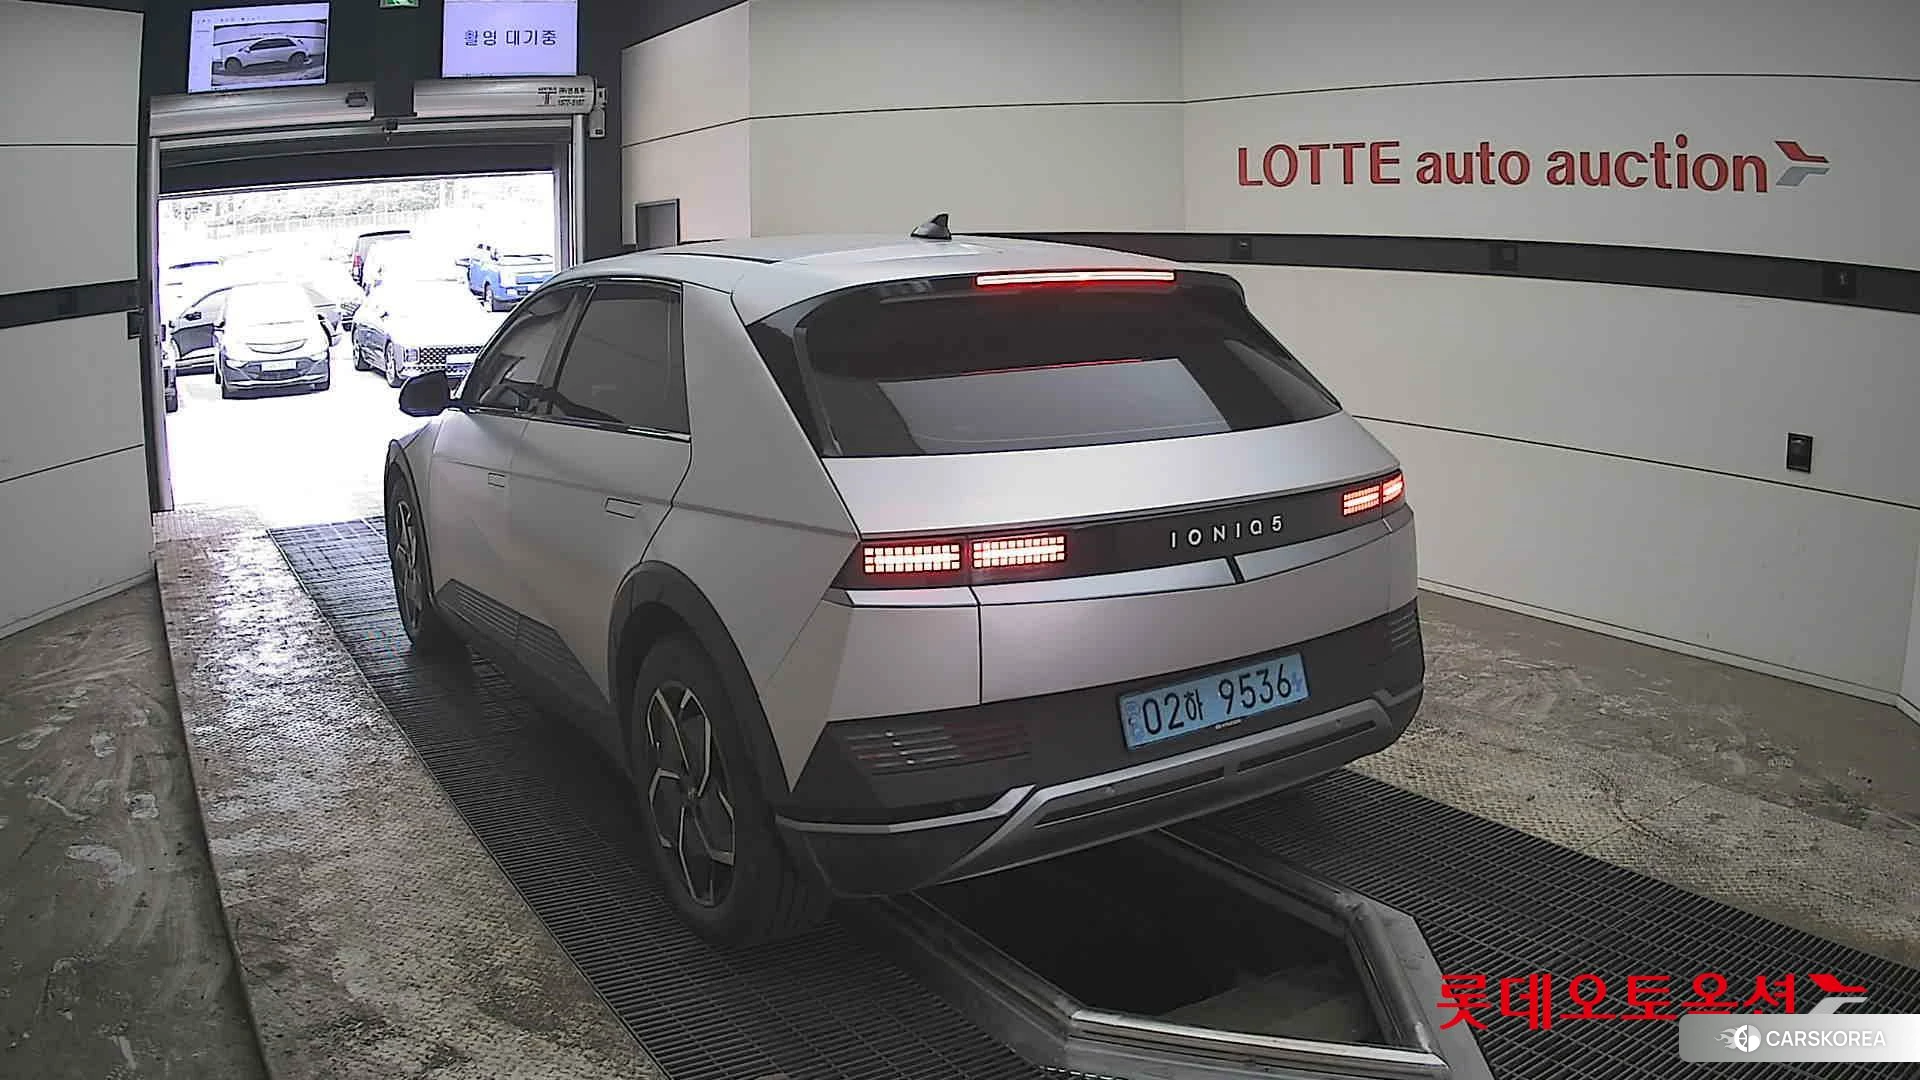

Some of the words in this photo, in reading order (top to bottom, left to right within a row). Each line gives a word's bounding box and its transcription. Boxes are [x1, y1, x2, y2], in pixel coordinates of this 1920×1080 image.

[505, 29, 557, 46] 대기중
[1237, 140, 1401, 188] LOTTE
[1415, 141, 1531, 187] auto
[1545, 134, 1769, 193] auction
[1142, 688, 1204, 735] 02하
[1217, 663, 1292, 715] 9536
